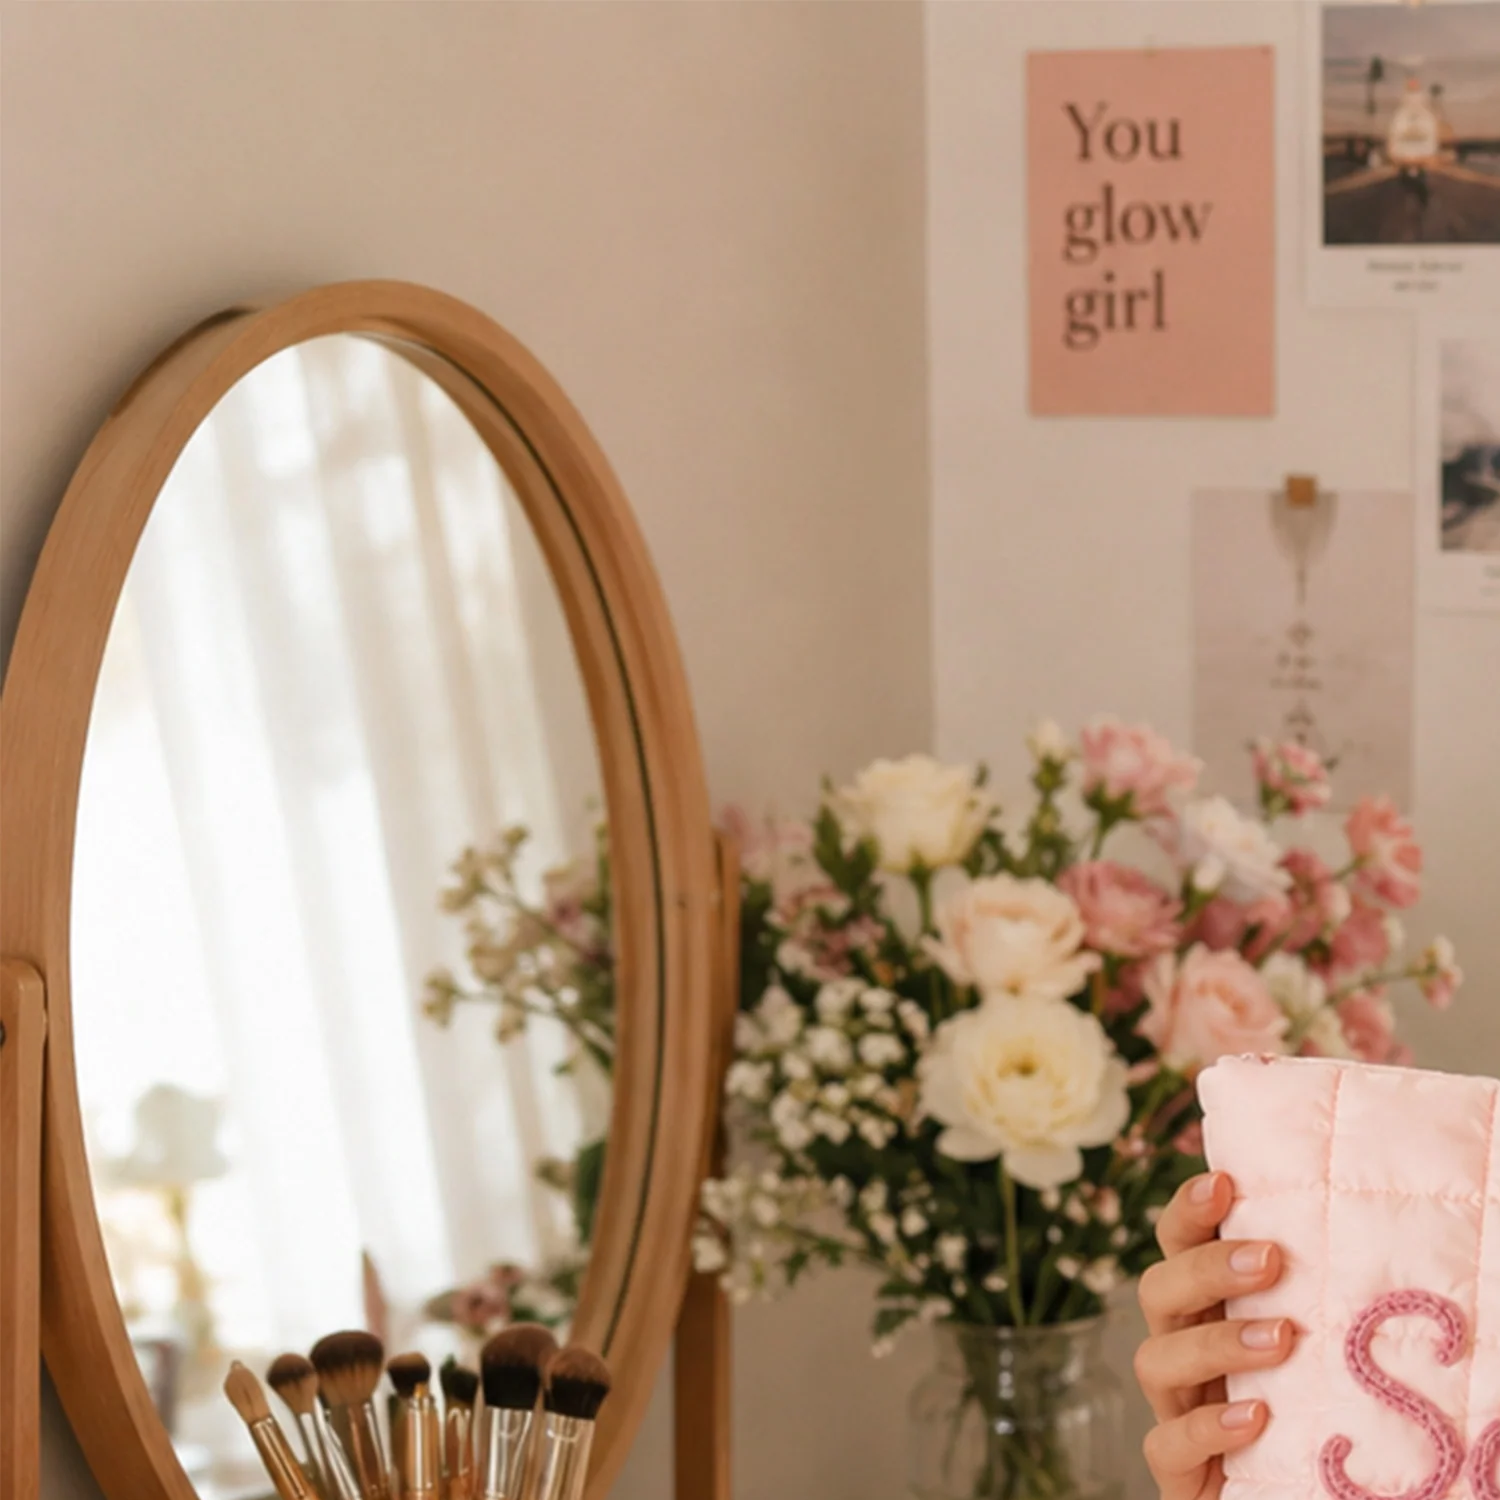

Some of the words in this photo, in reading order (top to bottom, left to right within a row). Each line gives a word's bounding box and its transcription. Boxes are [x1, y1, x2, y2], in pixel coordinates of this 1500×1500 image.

[1062, 101, 1183, 163] You
[1062, 181, 1213, 265] glow
[1062, 268, 1168, 352] girl
